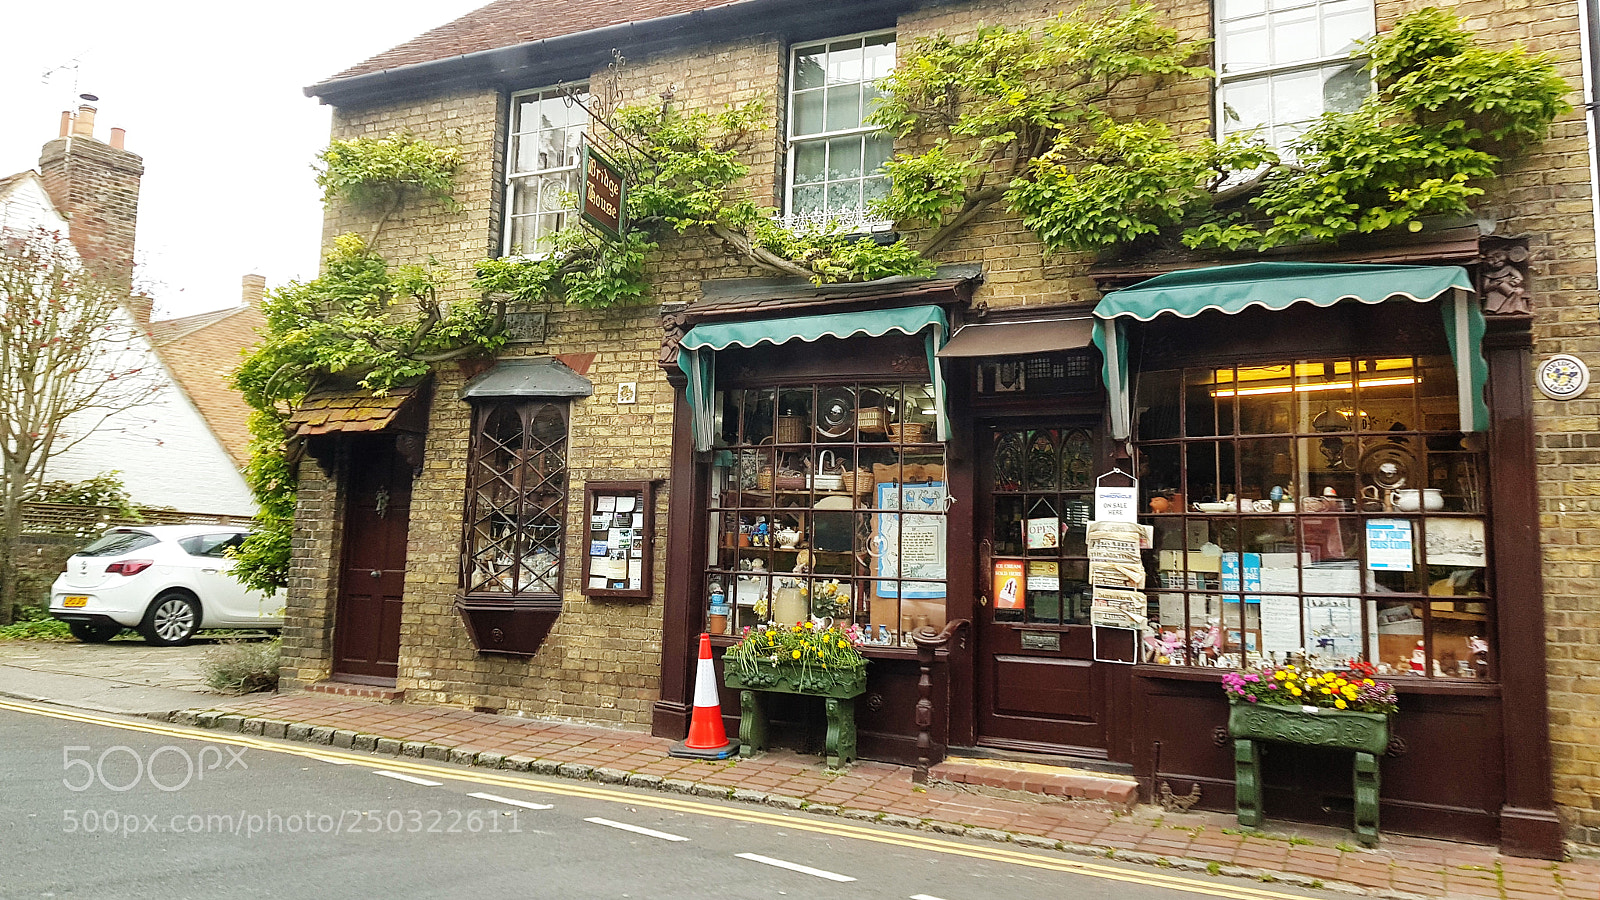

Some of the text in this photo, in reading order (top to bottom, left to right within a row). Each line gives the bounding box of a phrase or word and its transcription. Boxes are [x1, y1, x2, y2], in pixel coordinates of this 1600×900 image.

[587, 156, 619, 197] Bridge
[586, 180, 617, 219] House
[1029, 525, 1056, 534] OPEN
[1369, 530, 1406, 541] for your
[1370, 540, 1412, 549] custom
